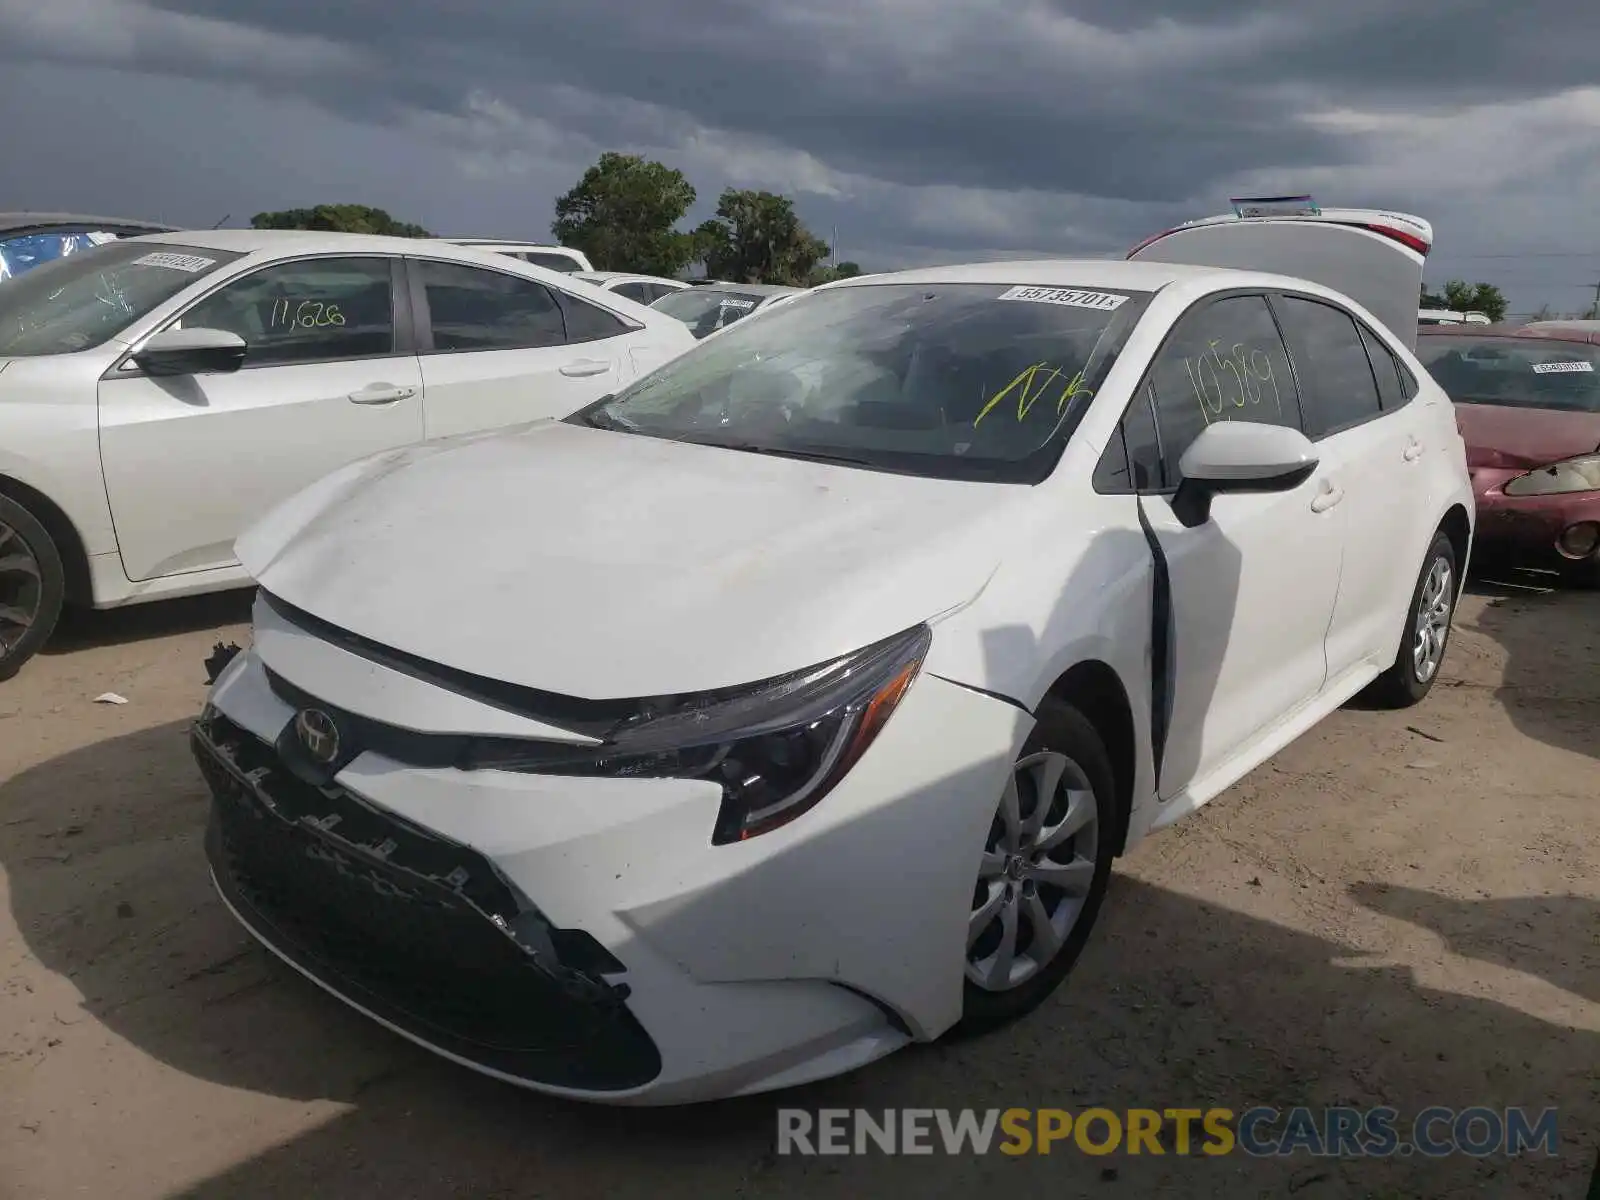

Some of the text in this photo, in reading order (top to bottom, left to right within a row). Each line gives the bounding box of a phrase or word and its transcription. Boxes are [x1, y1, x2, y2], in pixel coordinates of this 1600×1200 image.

[271, 296, 346, 335] 11,626
[1016, 288, 1110, 305] 55735701
[1185, 337, 1282, 427] 10589
